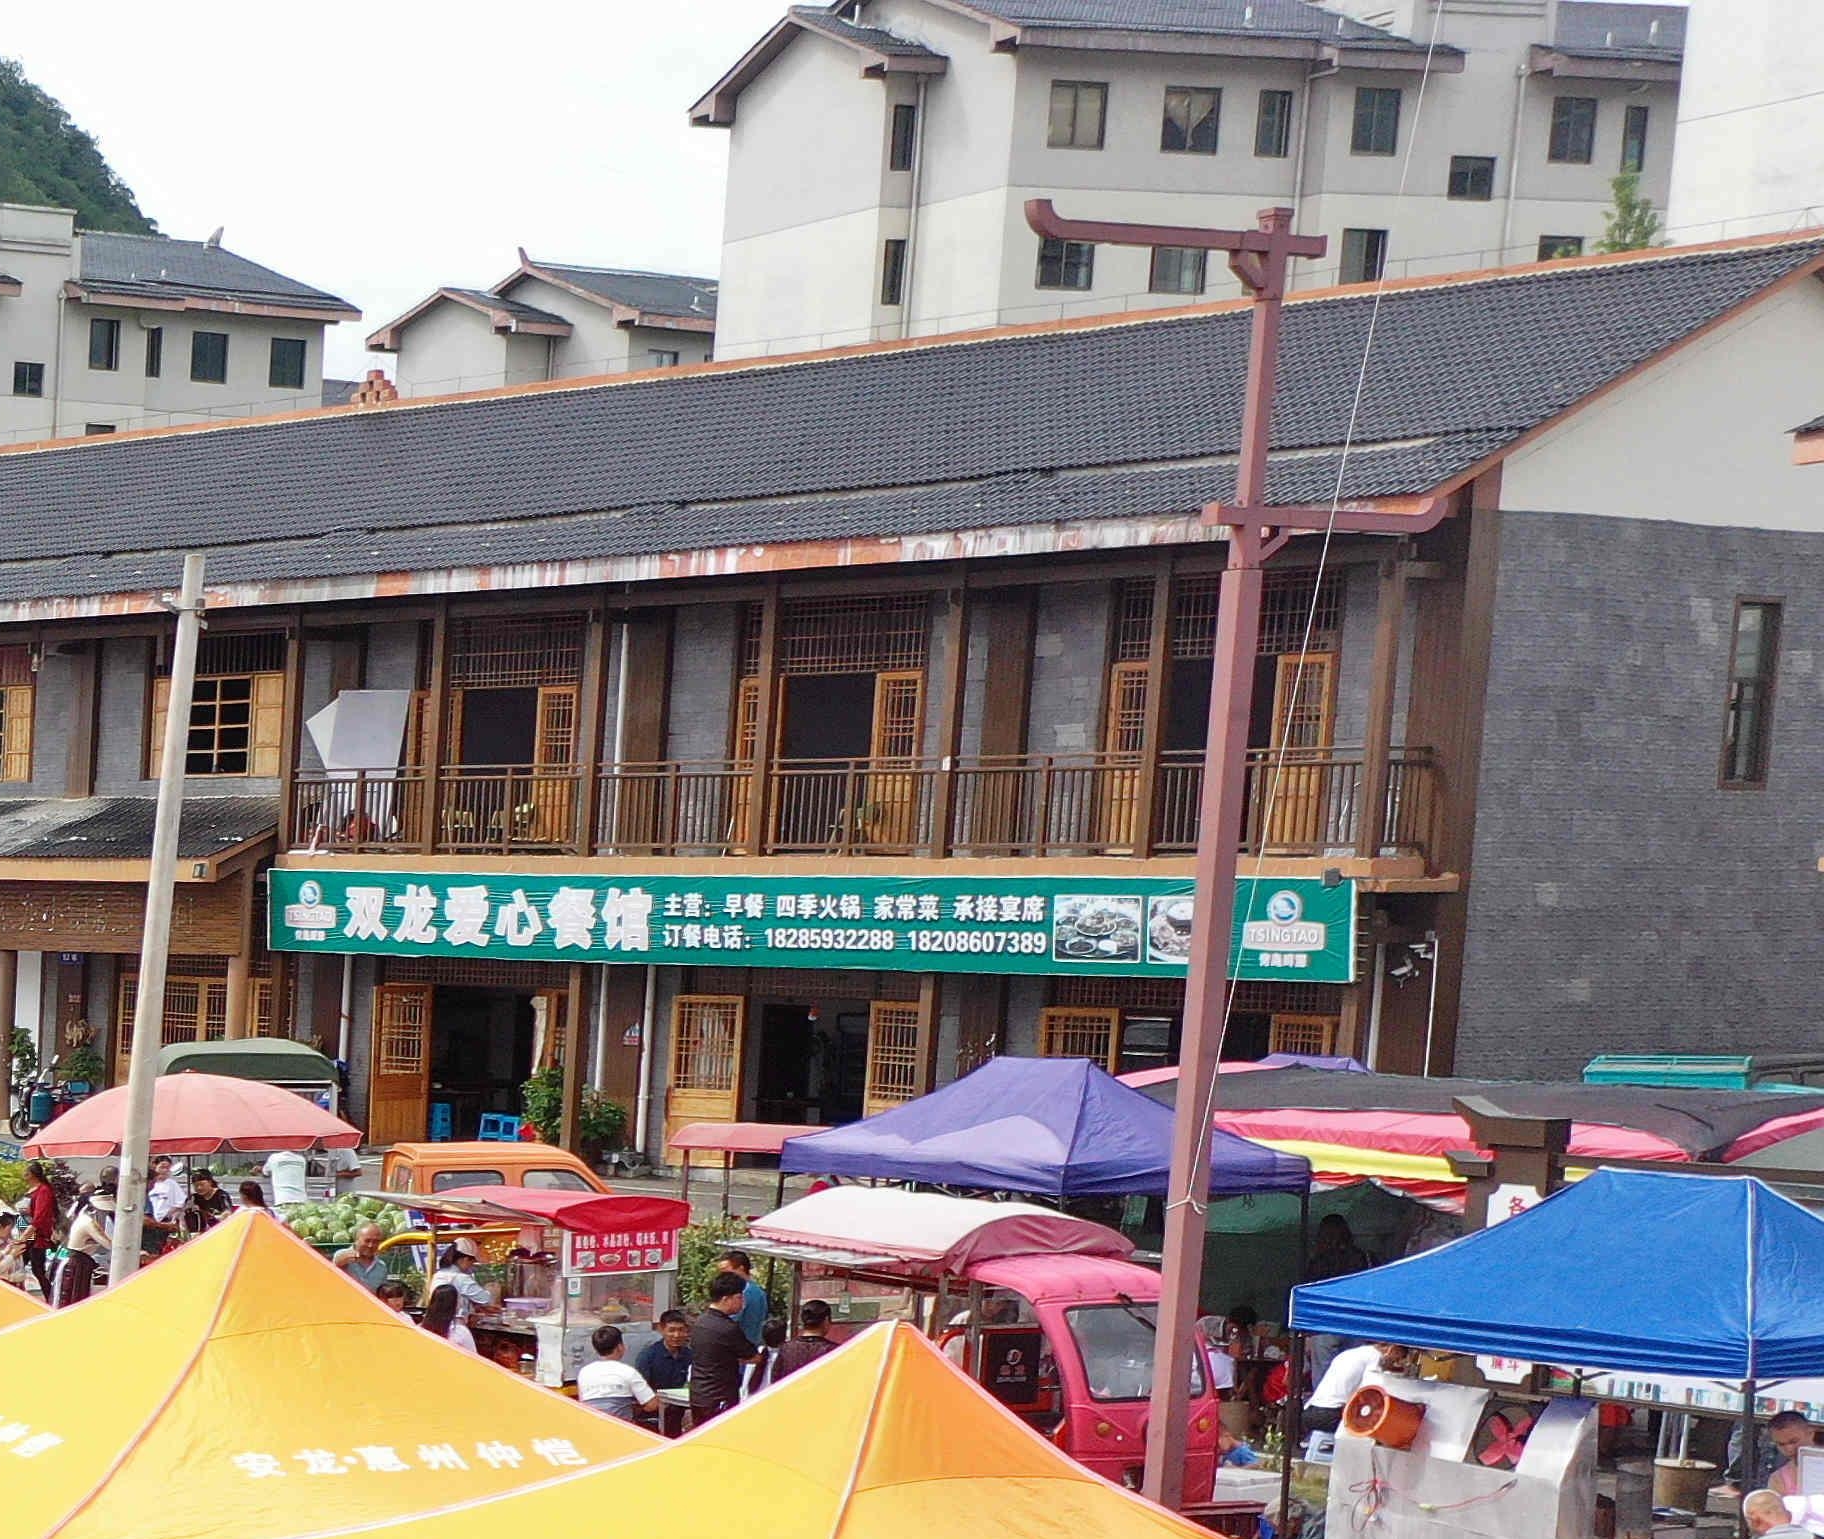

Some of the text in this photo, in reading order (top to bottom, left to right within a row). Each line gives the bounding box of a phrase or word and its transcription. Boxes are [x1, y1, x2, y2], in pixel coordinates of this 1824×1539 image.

[343, 884, 653, 952] 双龙爱心餐馆
[723, 894, 764, 919] 早餐
[776, 895, 861, 921] 四季火锅
[873, 896, 940, 921] 家常菜
[952, 896, 1045, 923] 承接宴席
[765, 928, 895, 952] 18285932288
[907, 930, 1047, 954] 18208607389
[1248, 927, 1319, 944] TSINGTAO
